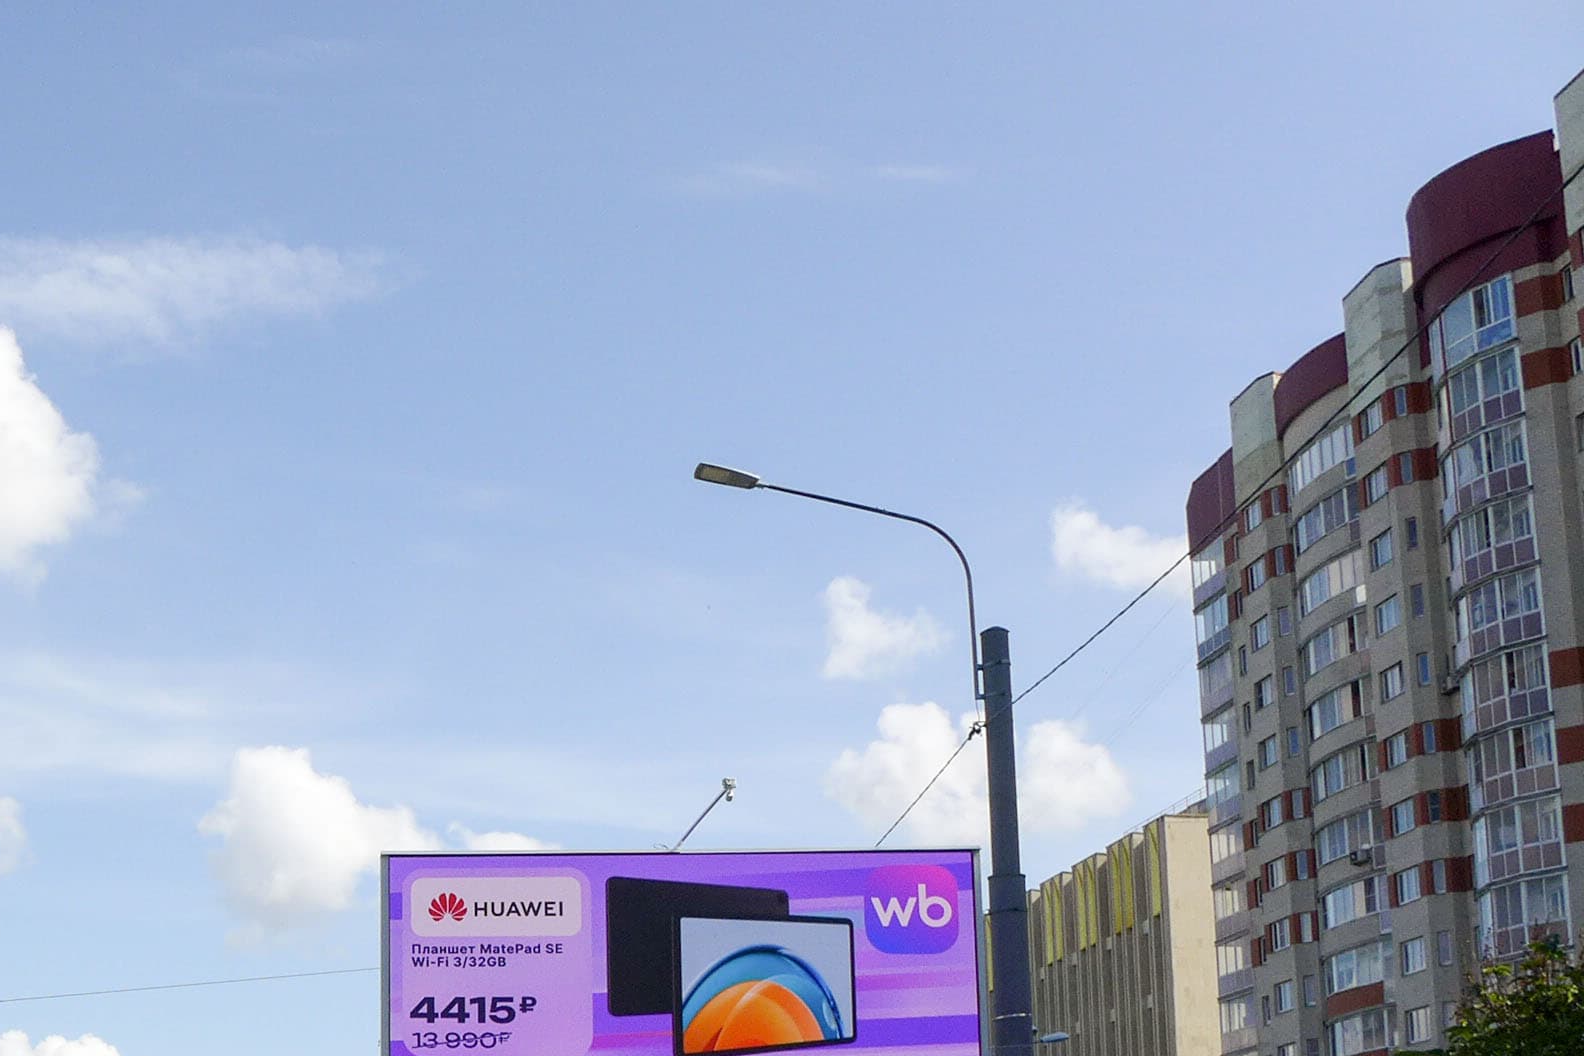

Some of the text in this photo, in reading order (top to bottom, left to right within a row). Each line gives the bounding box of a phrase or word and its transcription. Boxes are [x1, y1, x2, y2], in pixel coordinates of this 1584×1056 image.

[474, 901, 564, 917] HUAWEI
[871, 883, 953, 928] wb
[411, 943, 563, 955] Планшет MatePad SE
[411, 956, 507, 968] Wi-Fi 3/32GB
